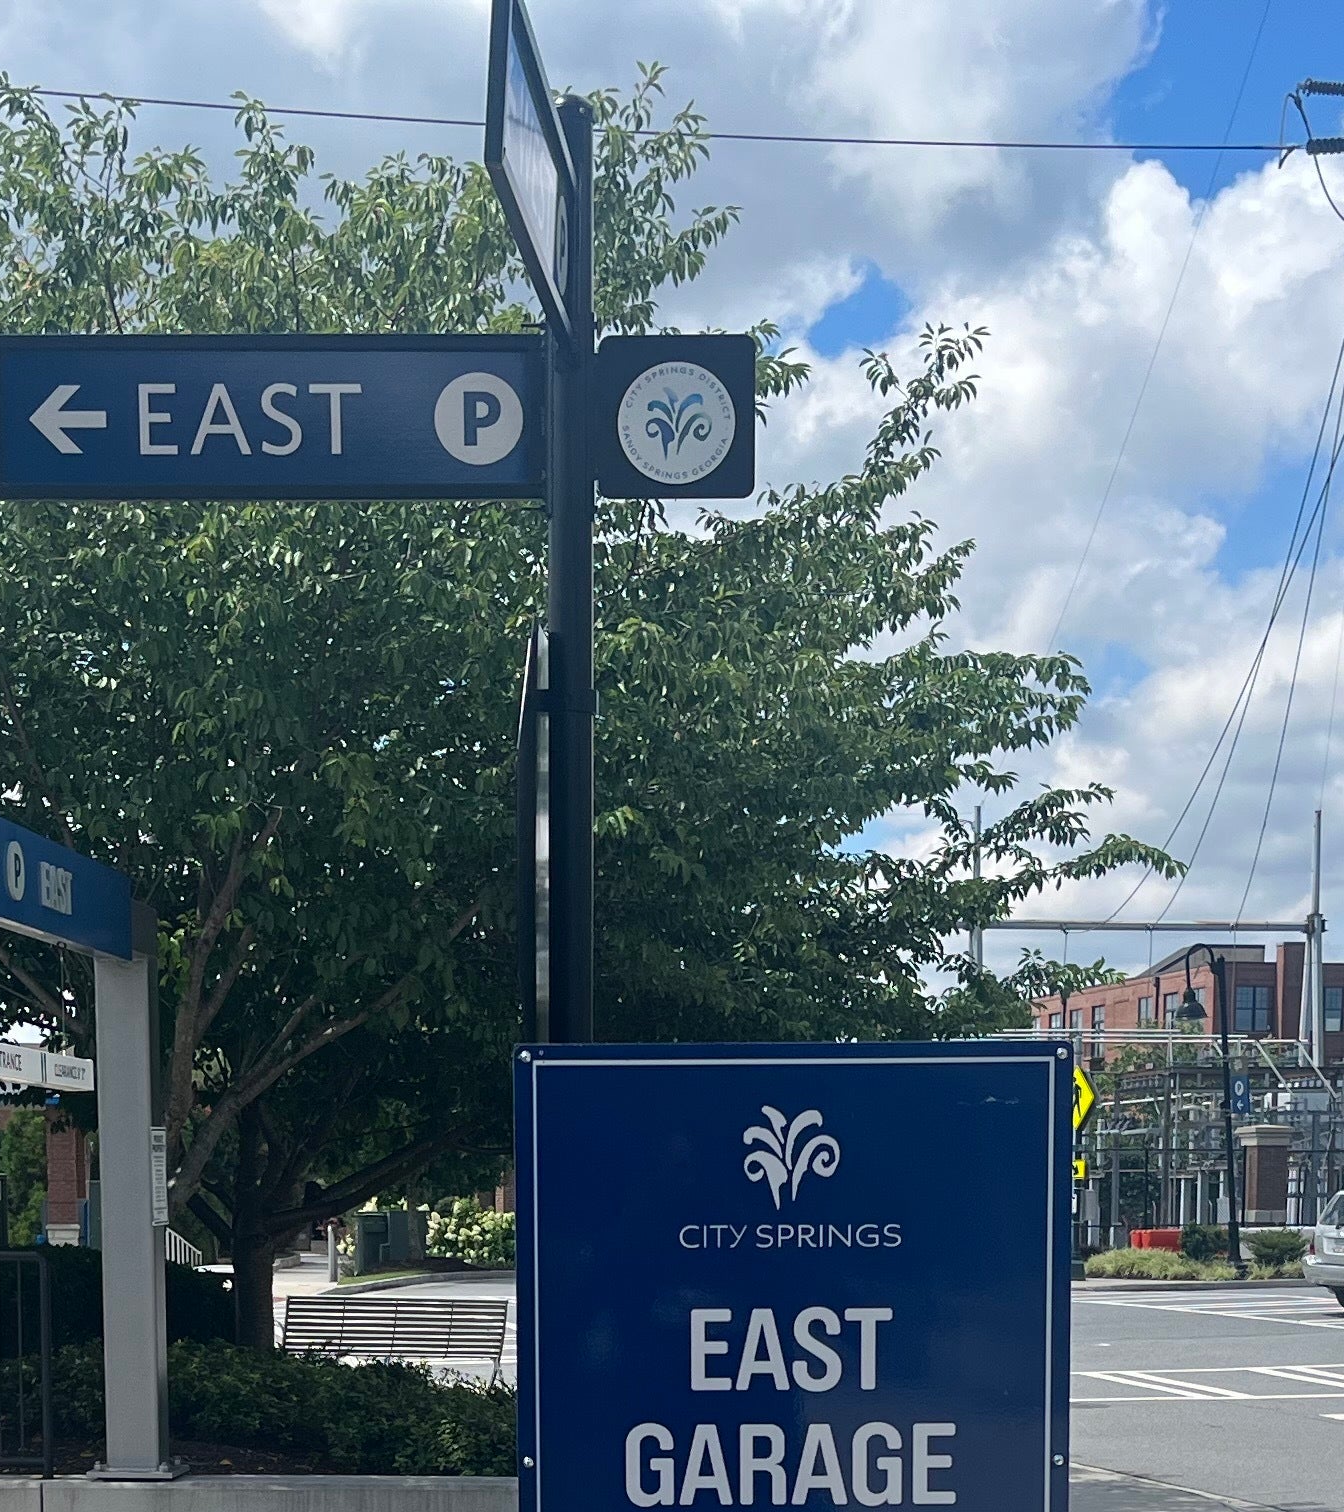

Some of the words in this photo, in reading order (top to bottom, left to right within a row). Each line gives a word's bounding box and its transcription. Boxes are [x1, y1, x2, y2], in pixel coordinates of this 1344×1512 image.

[137, 382, 362, 456] EAST
[463, 391, 501, 446] P
[626, 382, 644, 409] CITY
[644, 366, 696, 384] SPRINGS
[698, 373, 731, 420] DISTRICT
[621, 424, 645, 462] SANDY
[641, 460, 689, 481] SPRINGS
[690, 437, 729, 477] GEORGIA
[39, 861, 73, 916] EAST
[679, 1224, 748, 1249] CITY
[755, 1223, 902, 1248] SPRINGS
[690, 1306, 893, 1392] EAST
[625, 1422, 956, 1508] GARAGE
